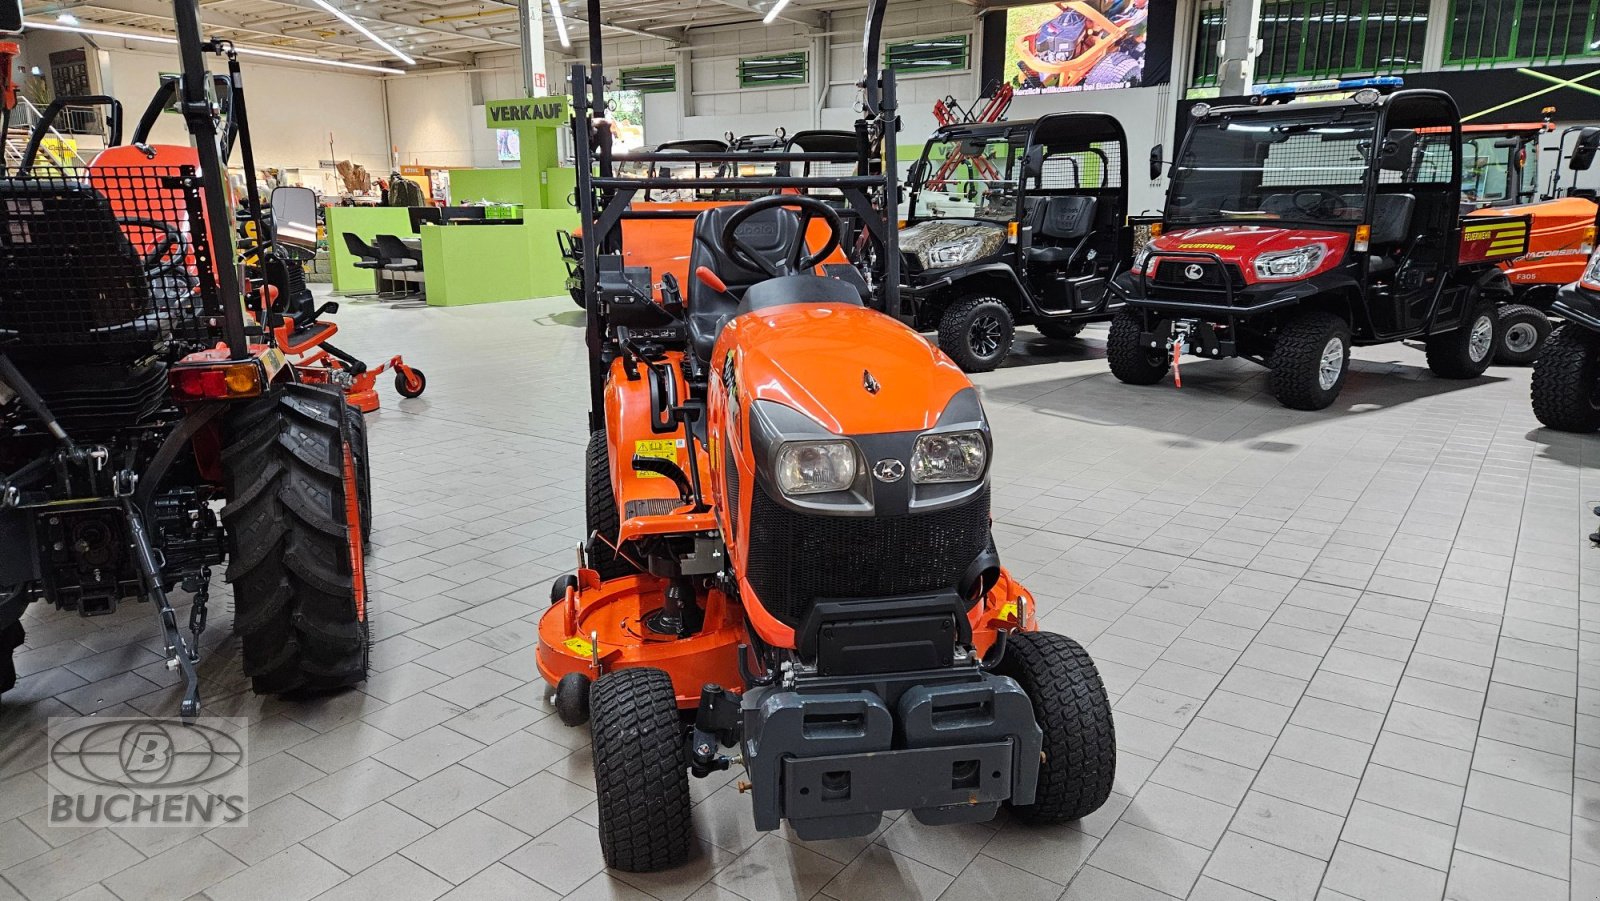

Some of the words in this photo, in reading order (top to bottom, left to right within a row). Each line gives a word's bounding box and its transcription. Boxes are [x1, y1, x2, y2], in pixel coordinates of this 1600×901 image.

[1013, 87, 1040, 96] Herzlich
[1041, 85, 1082, 94] willkommen
[490, 102, 562, 121] VERKAUF
[1464, 231, 1491, 241] FEUERWEHR
[1178, 243, 1236, 251] FEUERWEHR
